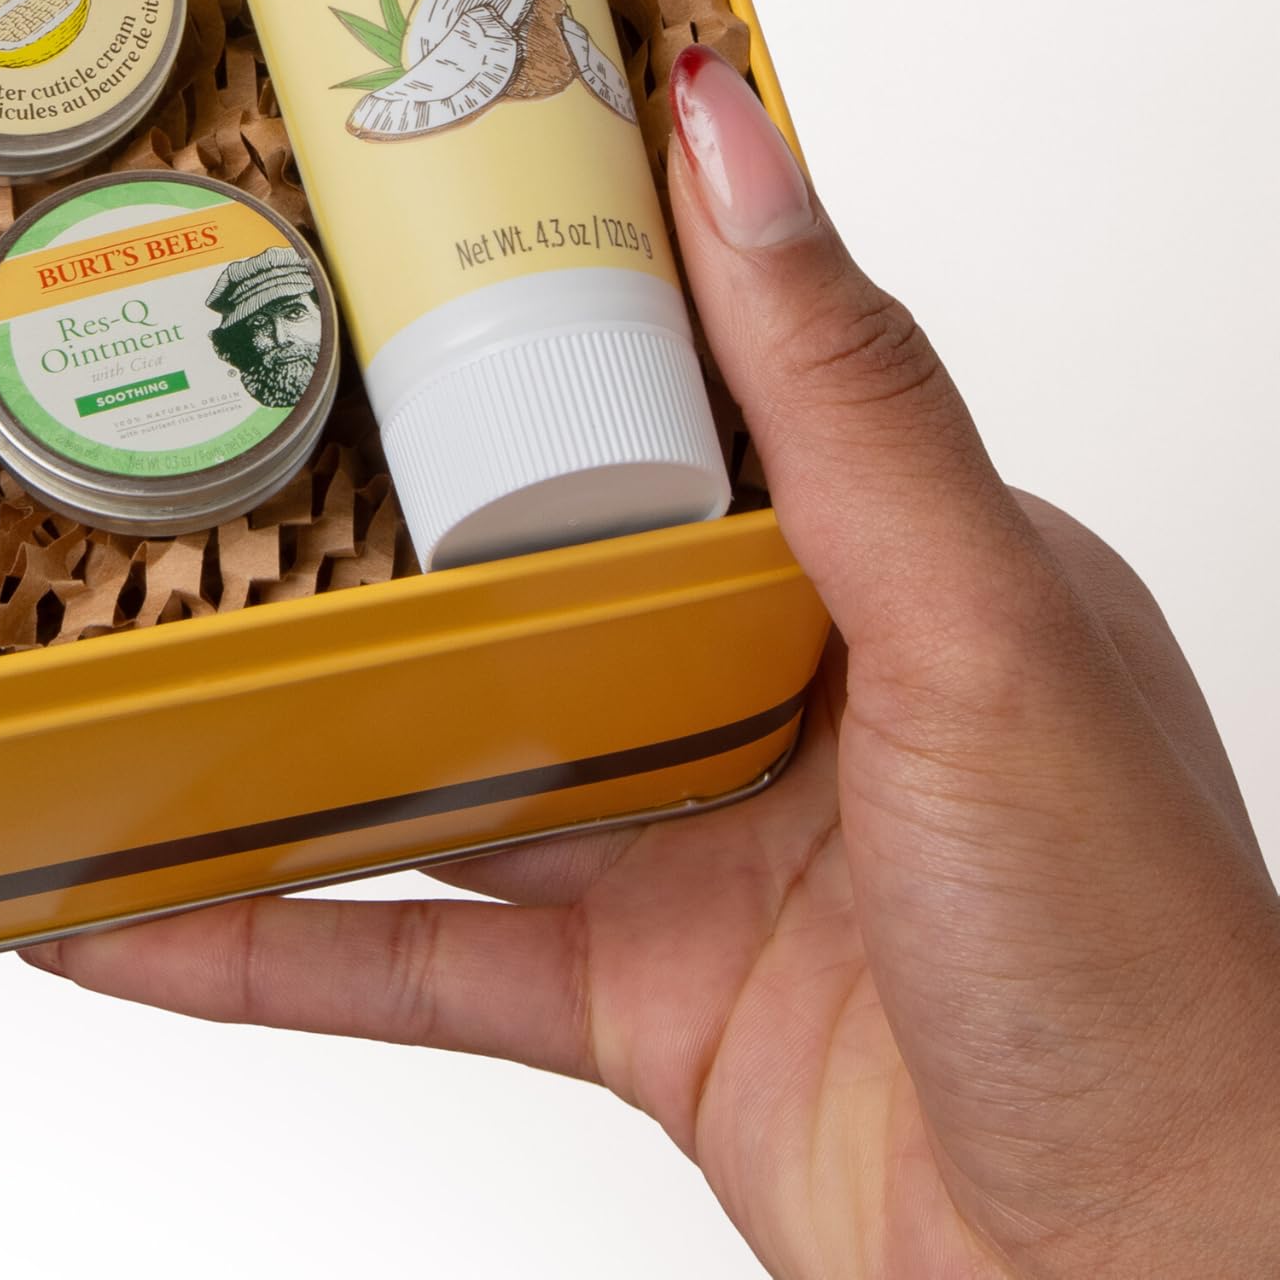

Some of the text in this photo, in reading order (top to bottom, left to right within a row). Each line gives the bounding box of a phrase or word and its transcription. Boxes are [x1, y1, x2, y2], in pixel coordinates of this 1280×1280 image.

[30, 65, 97, 101] cuticle
[96, 13, 136, 70] cream
[63, 96, 86, 114] au
[88, 50, 141, 101] beurre
[134, 26, 153, 51] de
[37, 227, 219, 290] BURT'S BEES
[455, 234, 495, 270] Net
[493, 226, 533, 257] Wt.
[536, 218, 565, 249] 4.3
[568, 224, 591, 246] oz
[601, 218, 640, 251] 121.9
[641, 232, 653, 260] g
[56, 298, 158, 343] Res-Q
[40, 321, 185, 374] Ointment
[91, 360, 127, 384] with
[96, 379, 169, 408] SOOTHING
